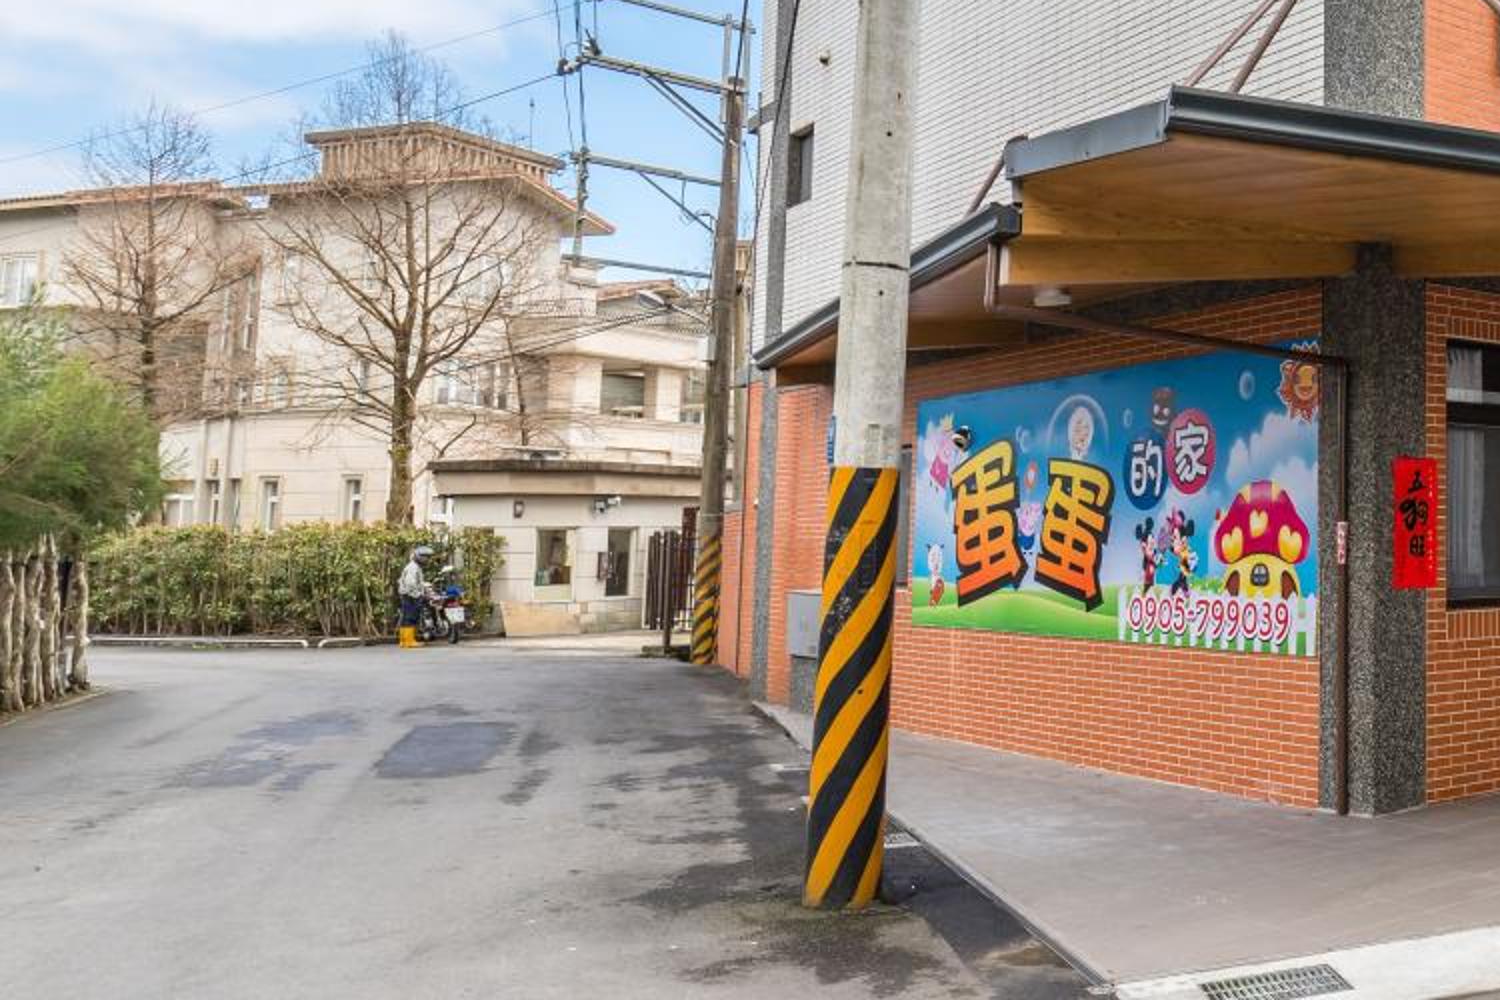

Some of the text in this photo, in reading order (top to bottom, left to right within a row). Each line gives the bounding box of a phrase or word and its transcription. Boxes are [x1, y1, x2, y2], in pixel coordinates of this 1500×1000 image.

[951, 420, 1209, 611] 蛋蛋的家
[1129, 596, 1290, 644] 0905-799039
